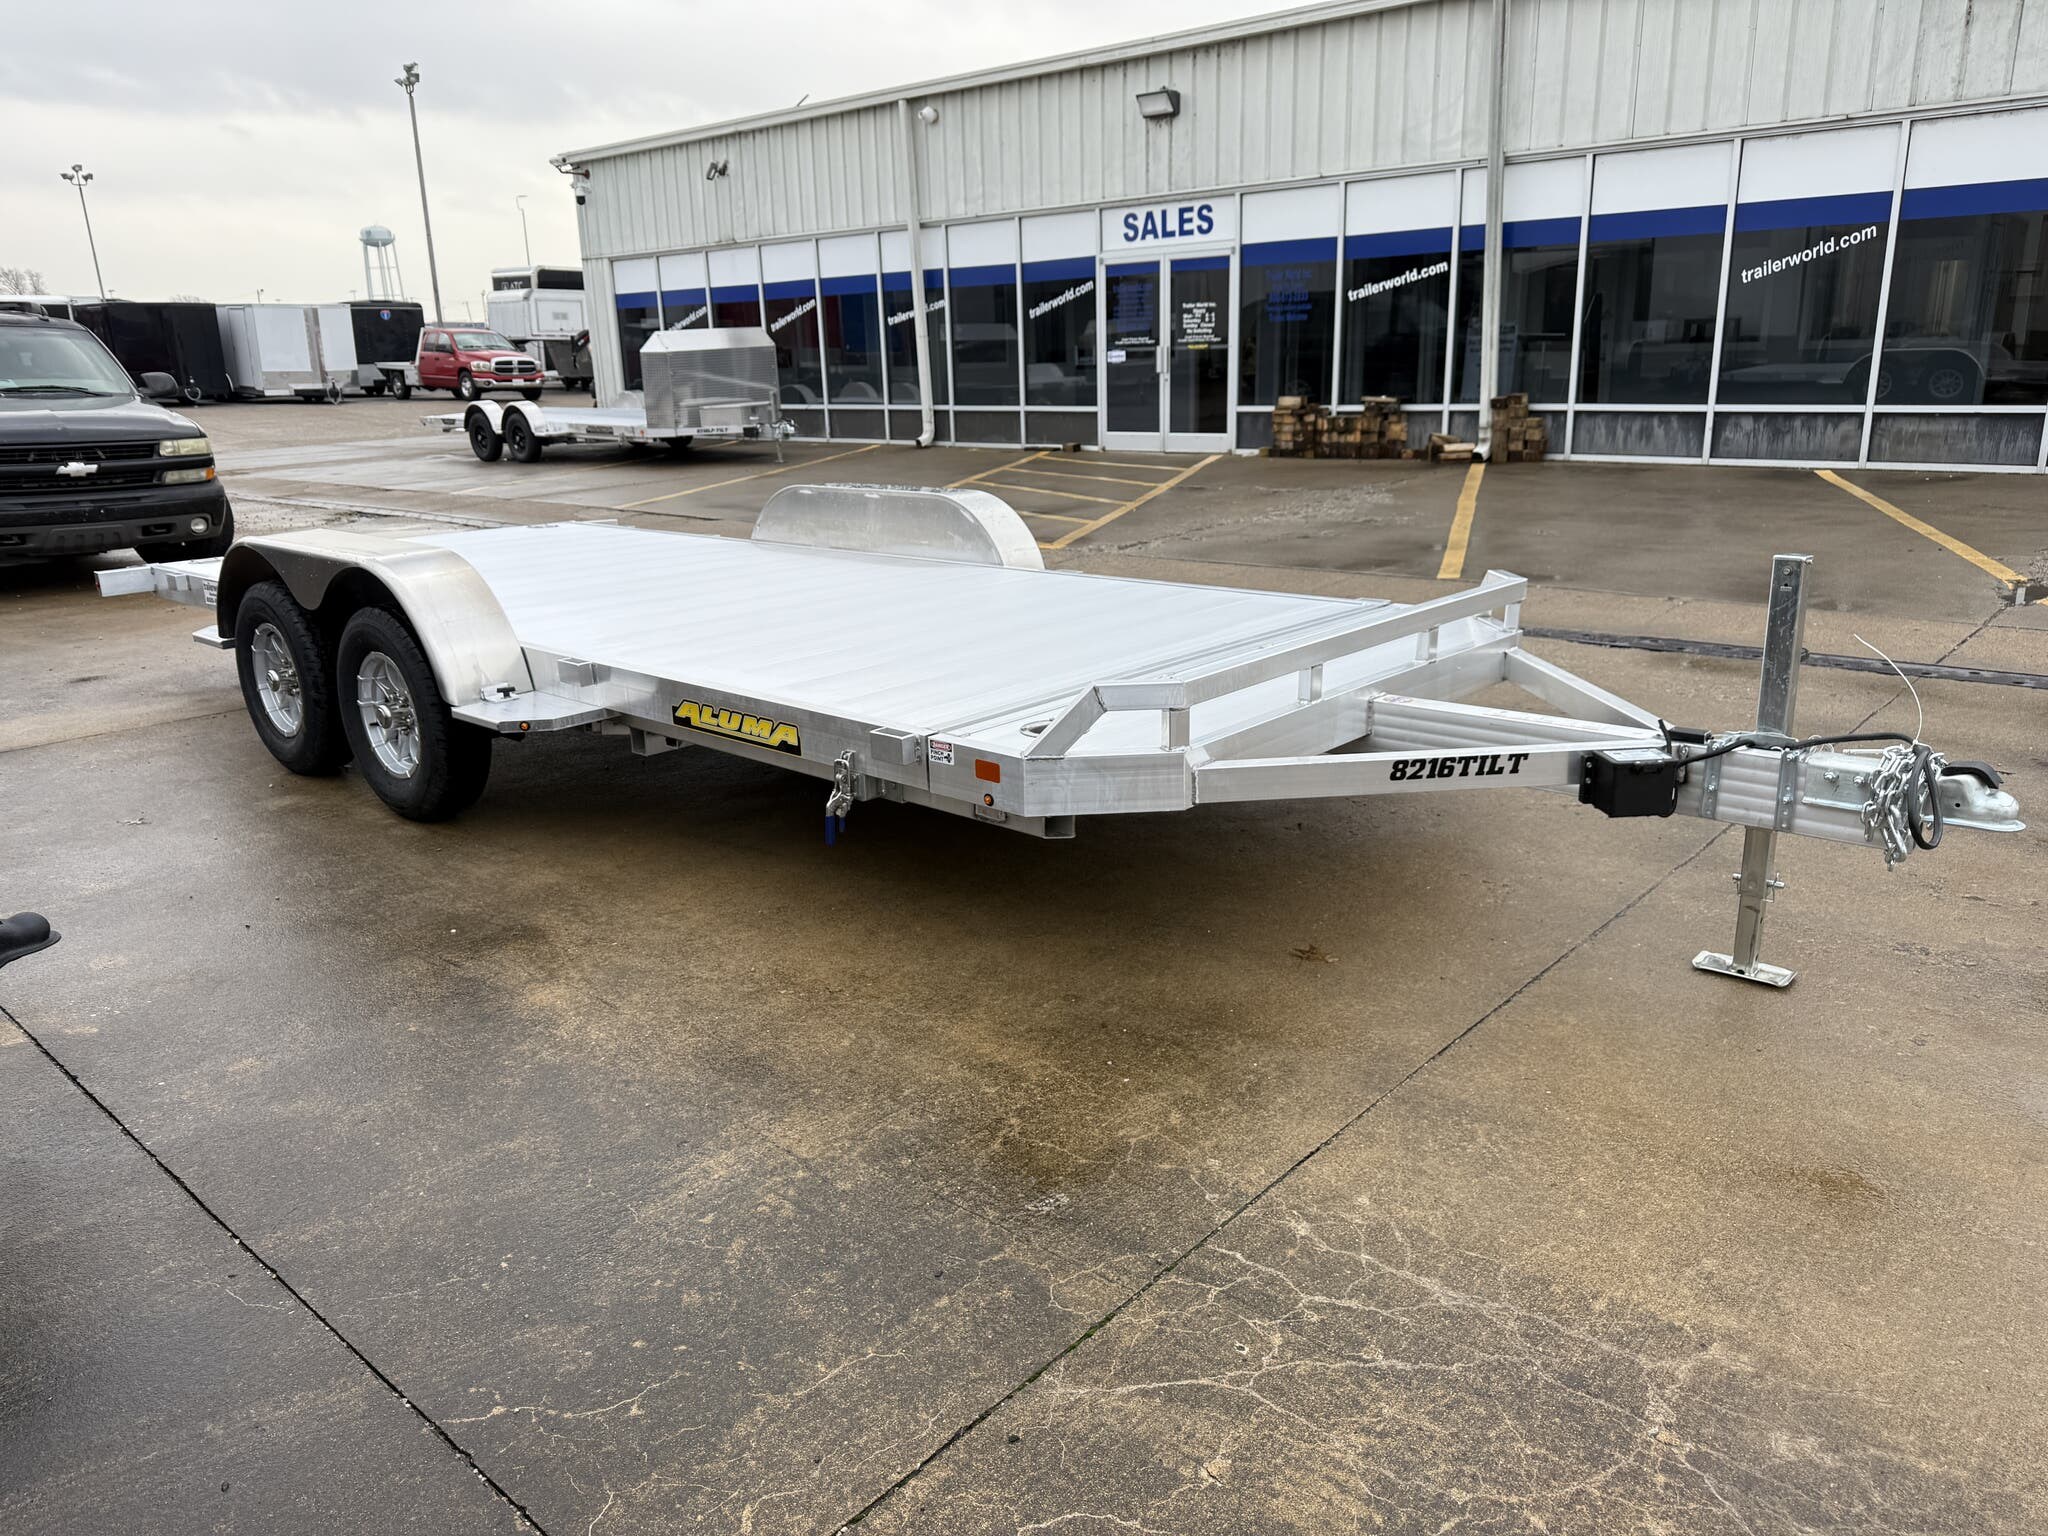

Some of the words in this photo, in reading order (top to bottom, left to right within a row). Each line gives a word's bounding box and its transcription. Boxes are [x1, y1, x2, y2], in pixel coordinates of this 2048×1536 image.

[1123, 204, 1214, 242] SALES
[1741, 225, 1877, 284] trailerworld.com
[1028, 280, 1095, 319] trailerworld.com
[1347, 261, 1449, 302] trailerworld.com
[674, 700, 801, 748] ALUMA
[930, 754, 944, 762] POINT
[1389, 752, 1530, 781] 8216TILT
